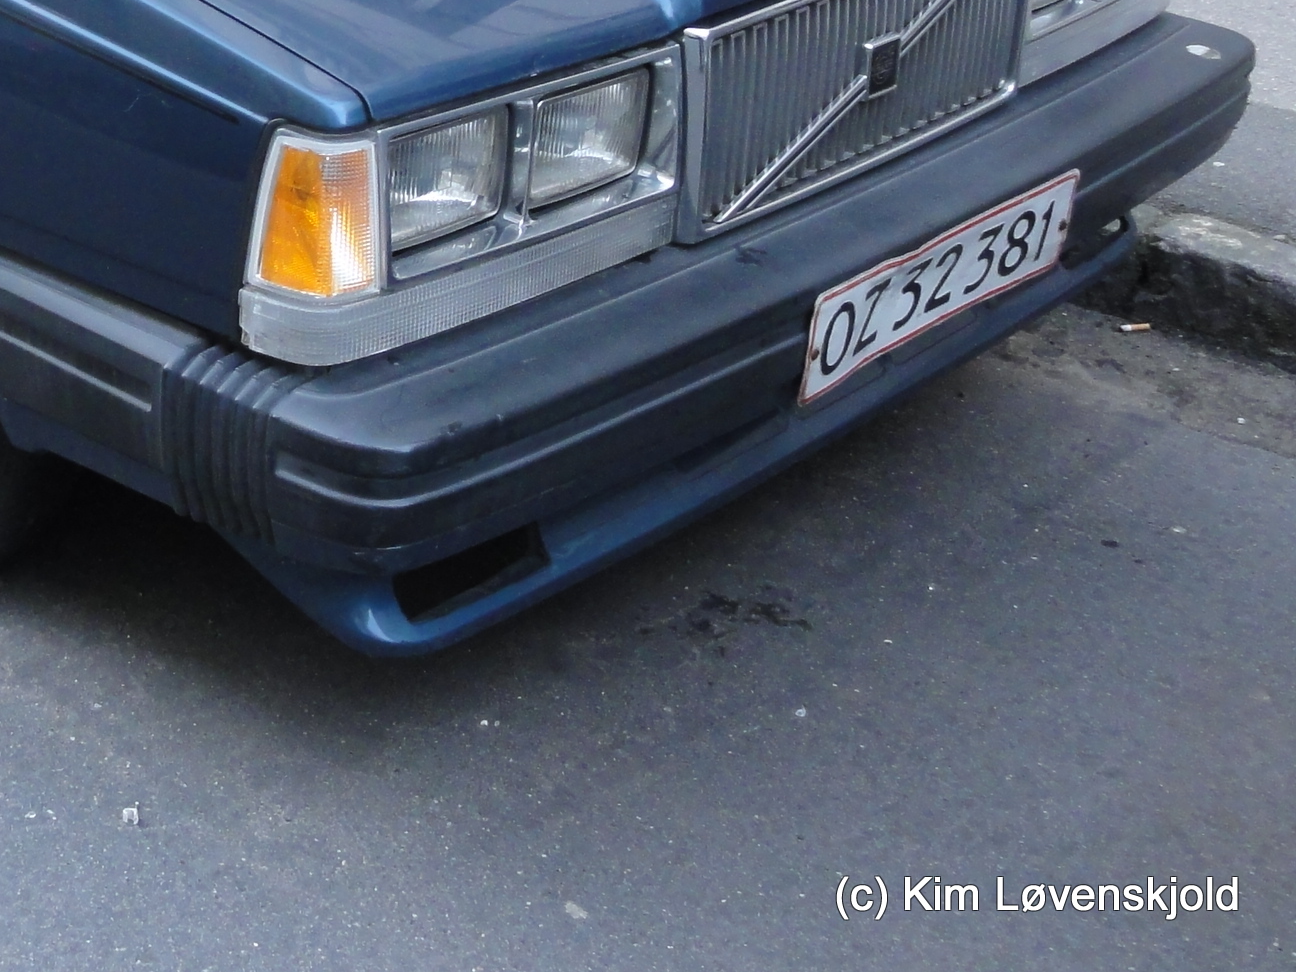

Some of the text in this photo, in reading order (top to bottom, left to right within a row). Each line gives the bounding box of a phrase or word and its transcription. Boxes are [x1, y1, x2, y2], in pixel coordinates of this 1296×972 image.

[820, 200, 1055, 375] OZ 32 381
